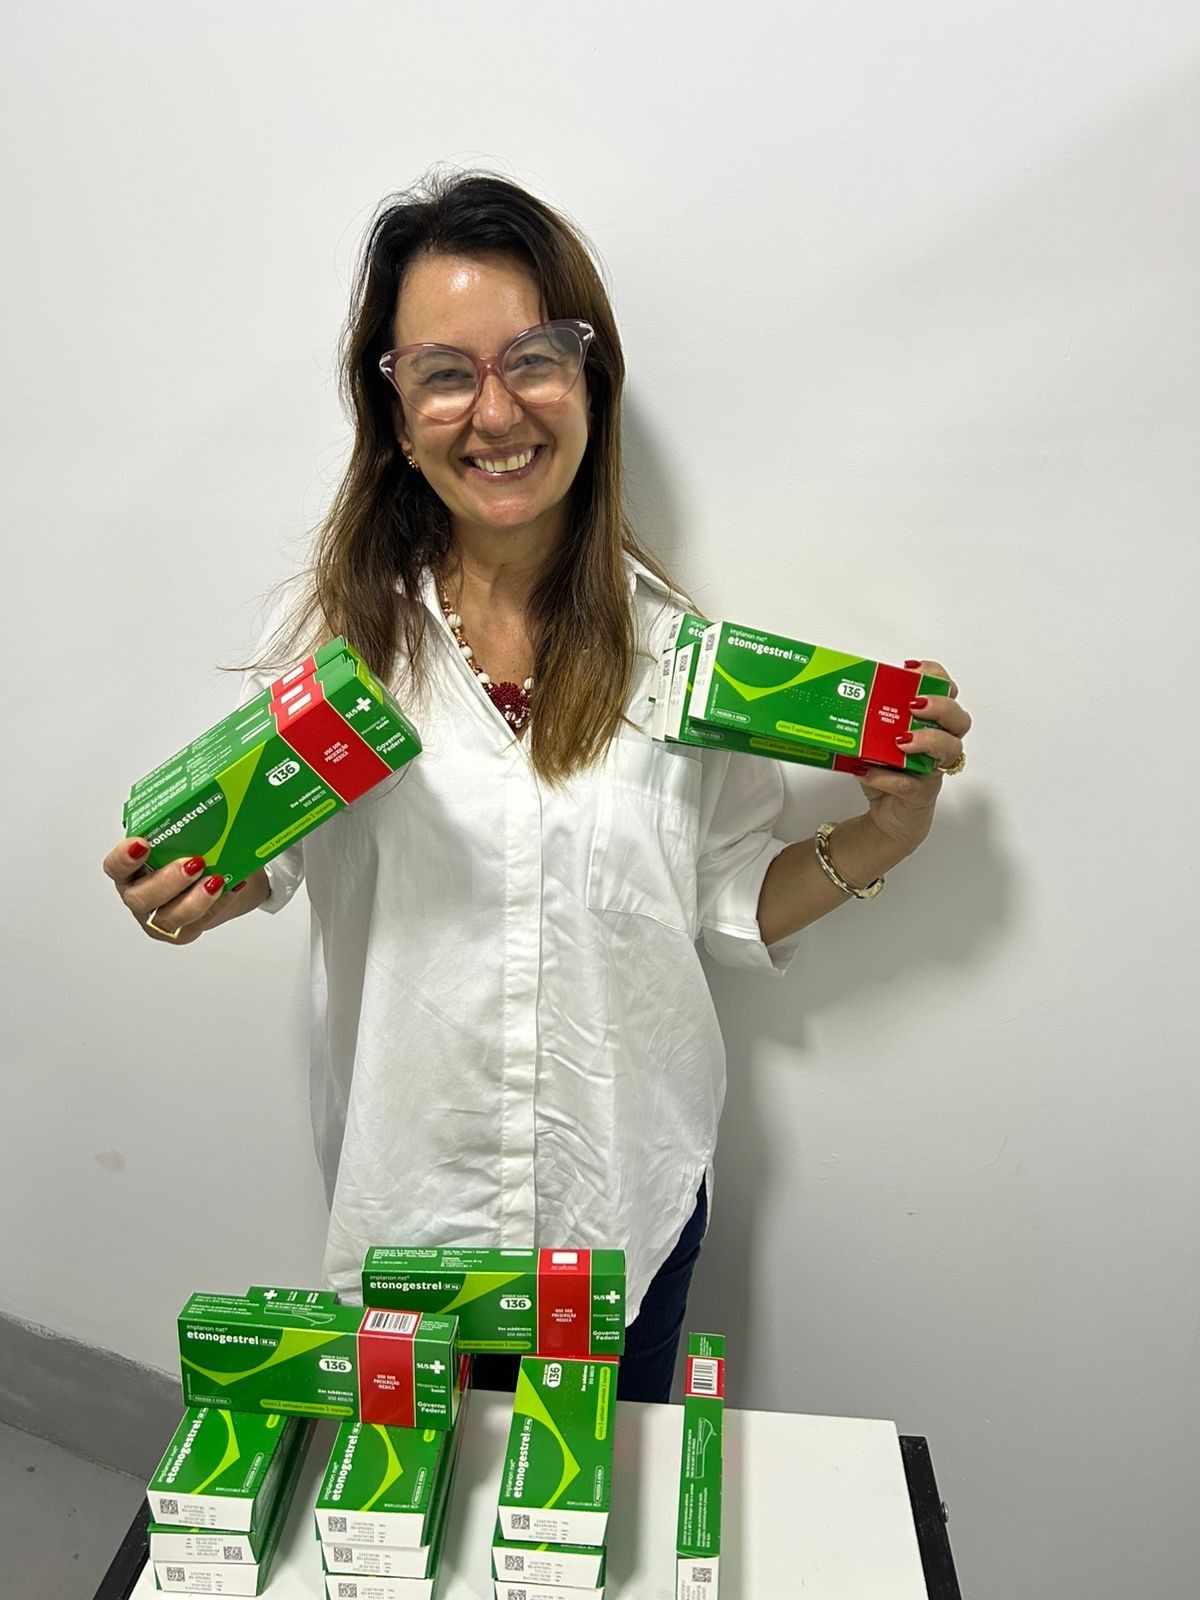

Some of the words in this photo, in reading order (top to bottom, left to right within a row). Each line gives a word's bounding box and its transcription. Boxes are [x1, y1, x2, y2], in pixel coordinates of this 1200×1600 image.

[728, 636, 793, 660] etonogestrel
[843, 685, 860, 698] 136
[345, 708, 358, 720] SUS
[376, 732, 401, 751] Governo
[383, 735, 406, 754] Federal
[272, 764, 296, 782] 136
[370, 1281, 442, 1292] etonogestrel
[506, 1300, 526, 1308] 136
[187, 1324, 214, 1332] implanon
[187, 1331, 258, 1344] etonogestrel
[324, 1361, 346, 1371] 136
[548, 1367, 560, 1382] 136
[166, 1420, 202, 1484] etonogestrel
[332, 1436, 358, 1501] etonogestrel
[514, 1432, 531, 1498] etonogestrel
[505, 1470, 514, 1498] implanon
